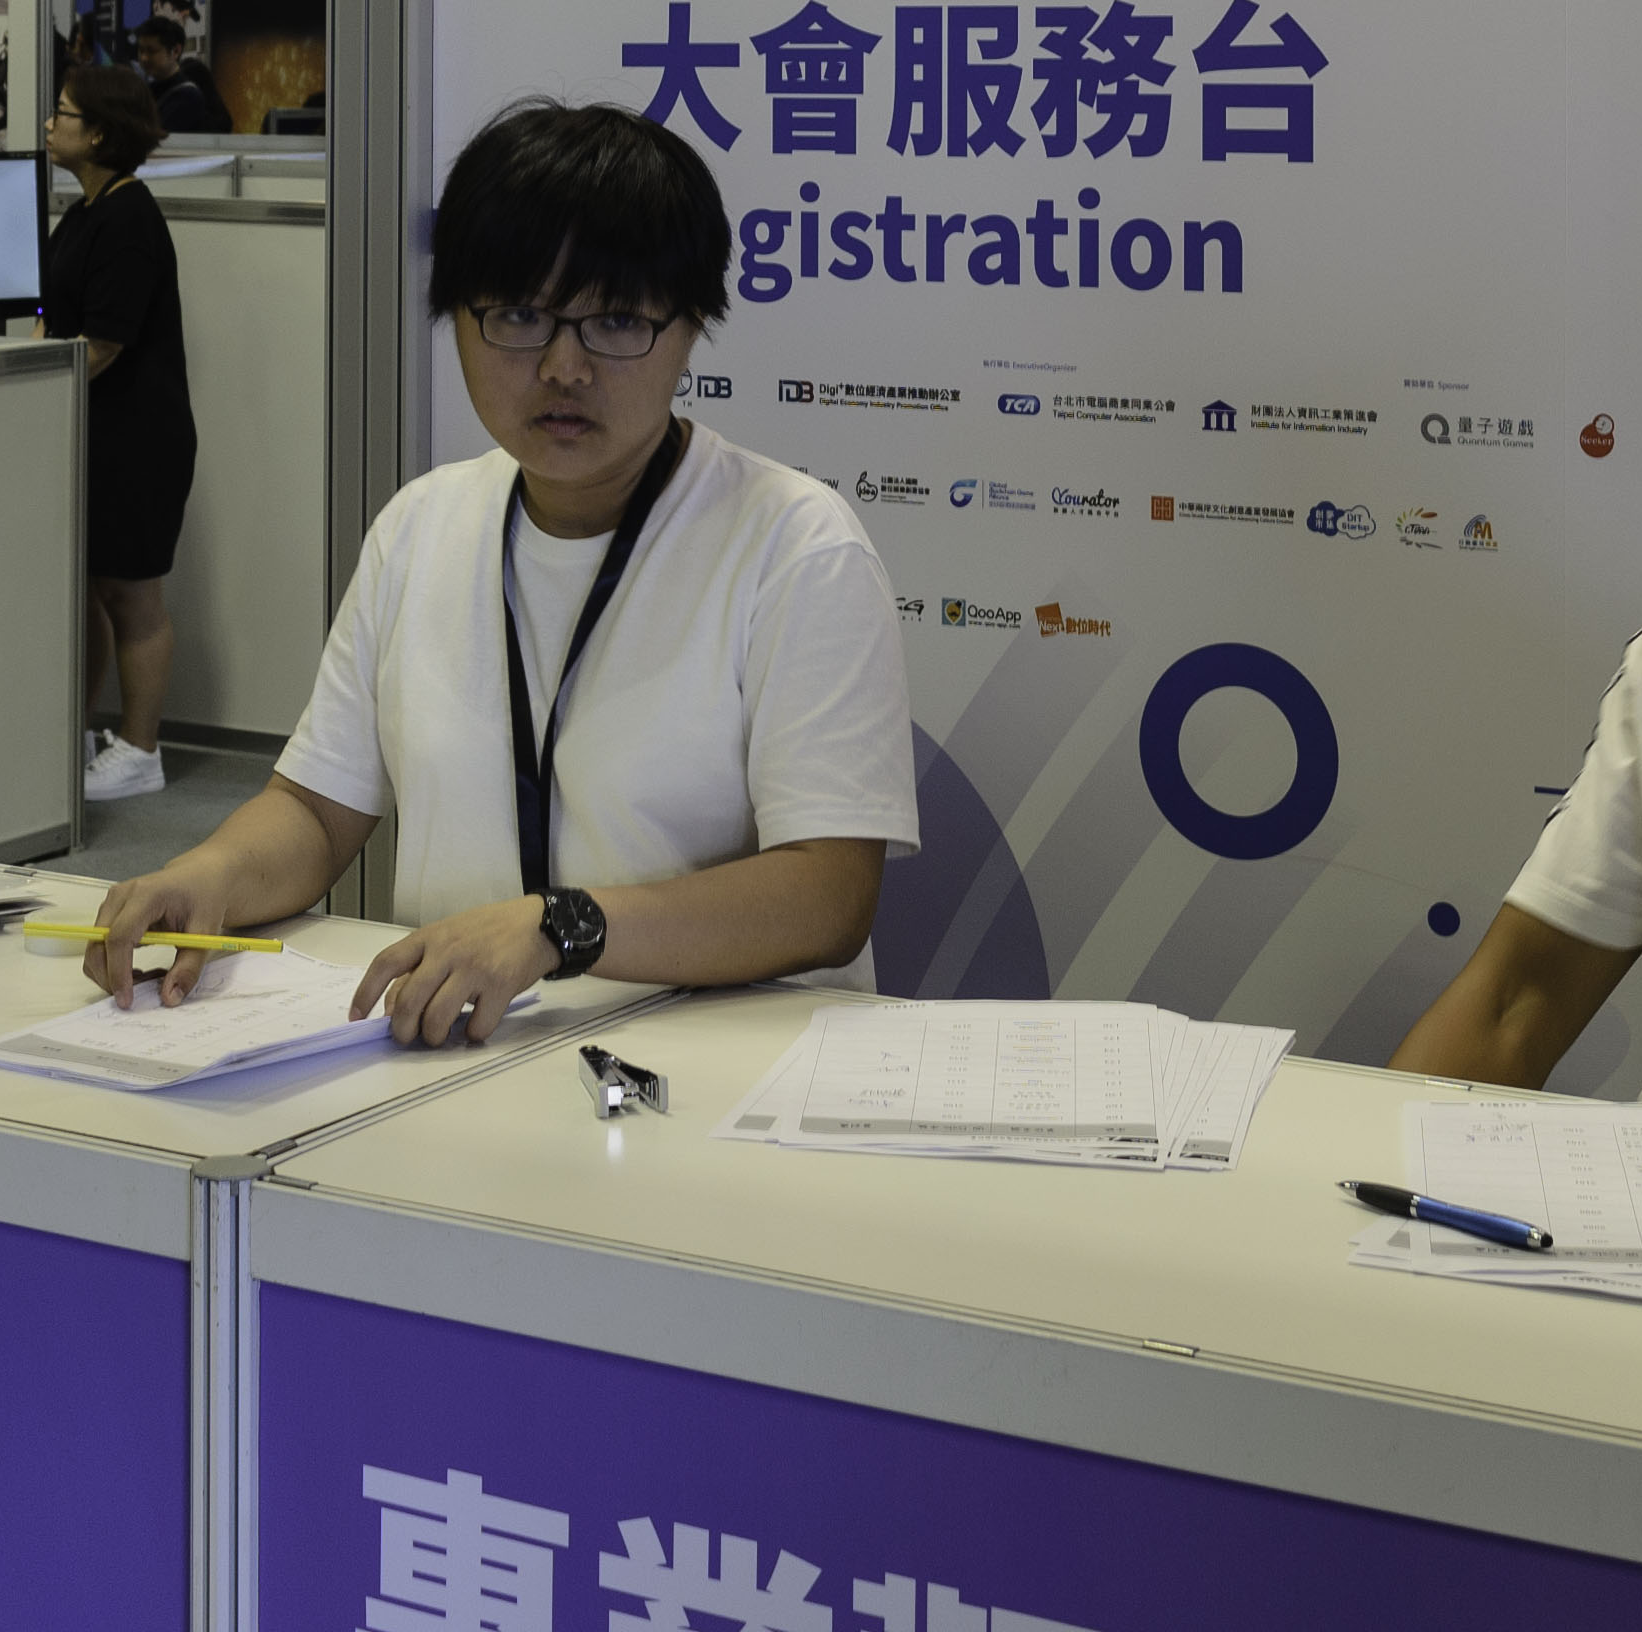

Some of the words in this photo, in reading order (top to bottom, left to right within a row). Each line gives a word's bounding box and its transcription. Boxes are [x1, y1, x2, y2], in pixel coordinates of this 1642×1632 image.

[737, 181, 1244, 304] gistration
[1438, 380, 1469, 391] Sponsor
[1003, 397, 1036, 413] TCA
[1053, 410, 1074, 422] Taipei
[1076, 411, 1113, 423] Computer
[1114, 413, 1156, 424] Association
[1251, 420, 1279, 431] Institute
[1281, 421, 1291, 431] for
[1294, 421, 1335, 433] Information
[1337, 424, 1368, 436] Industry
[1458, 436, 1500, 448] Quantum
[1502, 437, 1534, 449] Games
[1052, 486, 1120, 509] Yourator
[967, 604, 1022, 622] QooApp
